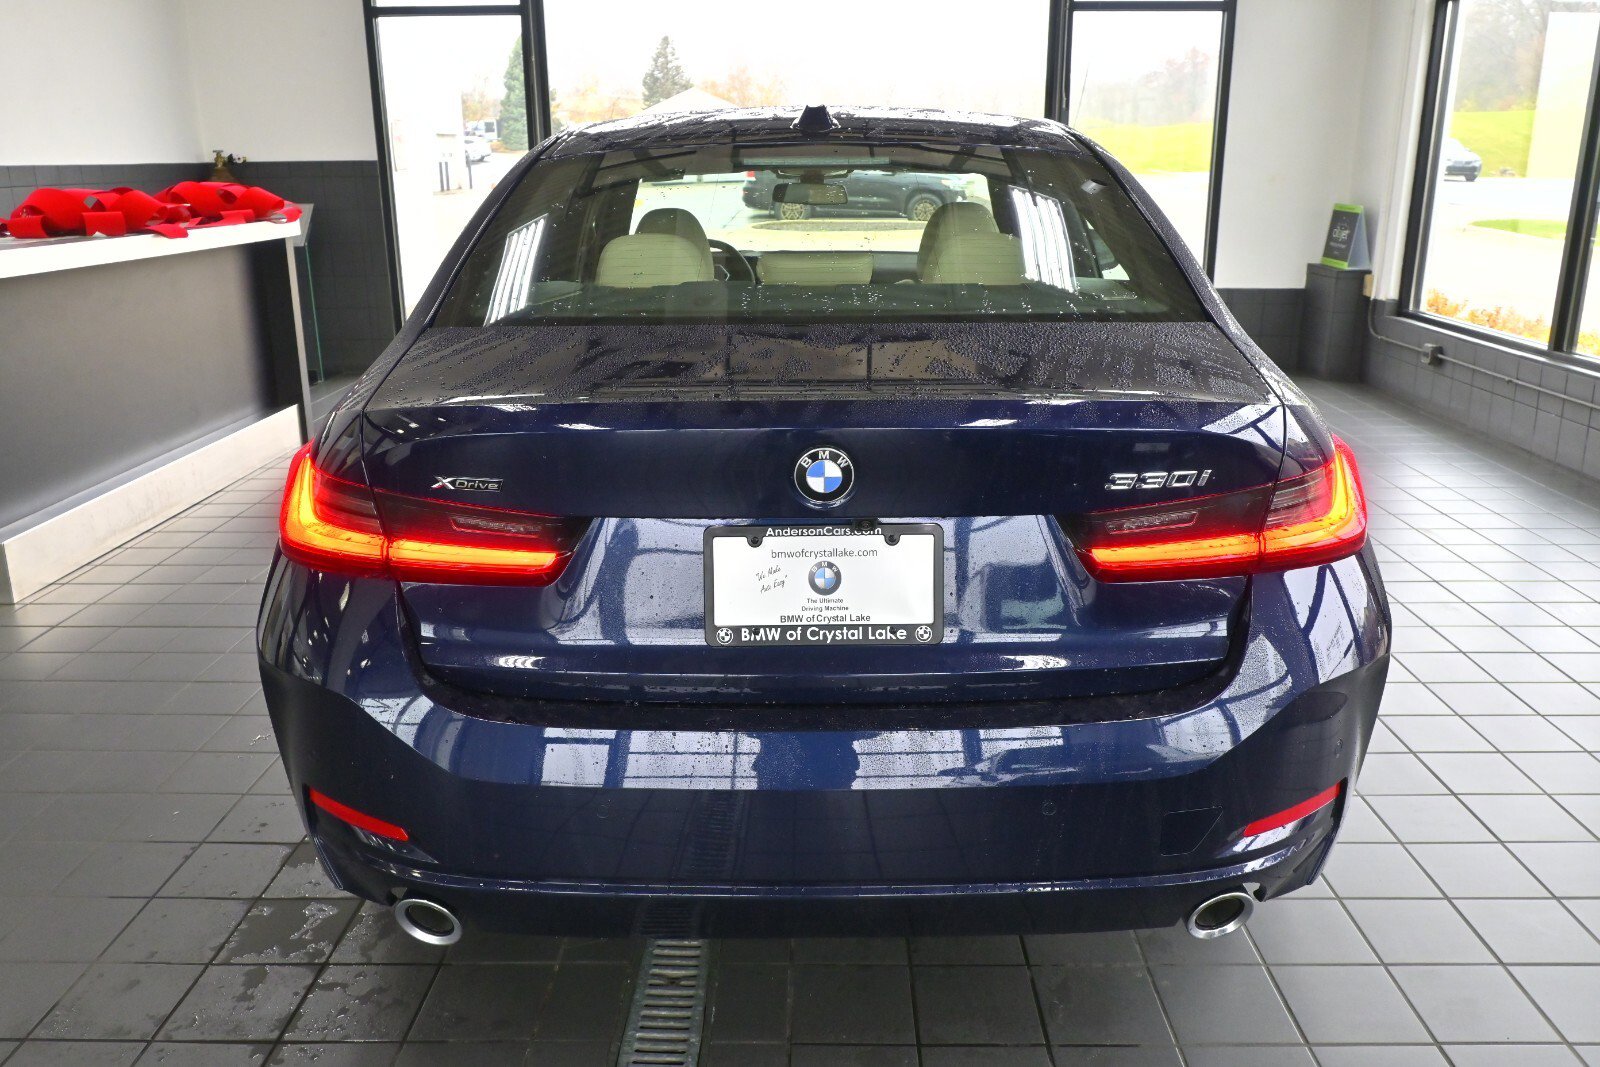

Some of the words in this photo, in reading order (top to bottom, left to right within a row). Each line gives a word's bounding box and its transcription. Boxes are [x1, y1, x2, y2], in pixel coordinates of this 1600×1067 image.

[800, 450, 849, 468] BMW
[1104, 469, 1212, 491] 330i
[771, 548, 878, 559] bmwofcrystallake.com
[780, 615, 804, 623] BMW
[805, 614, 816, 622] of
[816, 614, 847, 624] Crystal
[849, 614, 871, 622] Lake
[741, 627, 781, 642] BMW
[786, 626, 802, 641] of
[806, 626, 863, 644] Crystal
[868, 626, 907, 640] Lake
